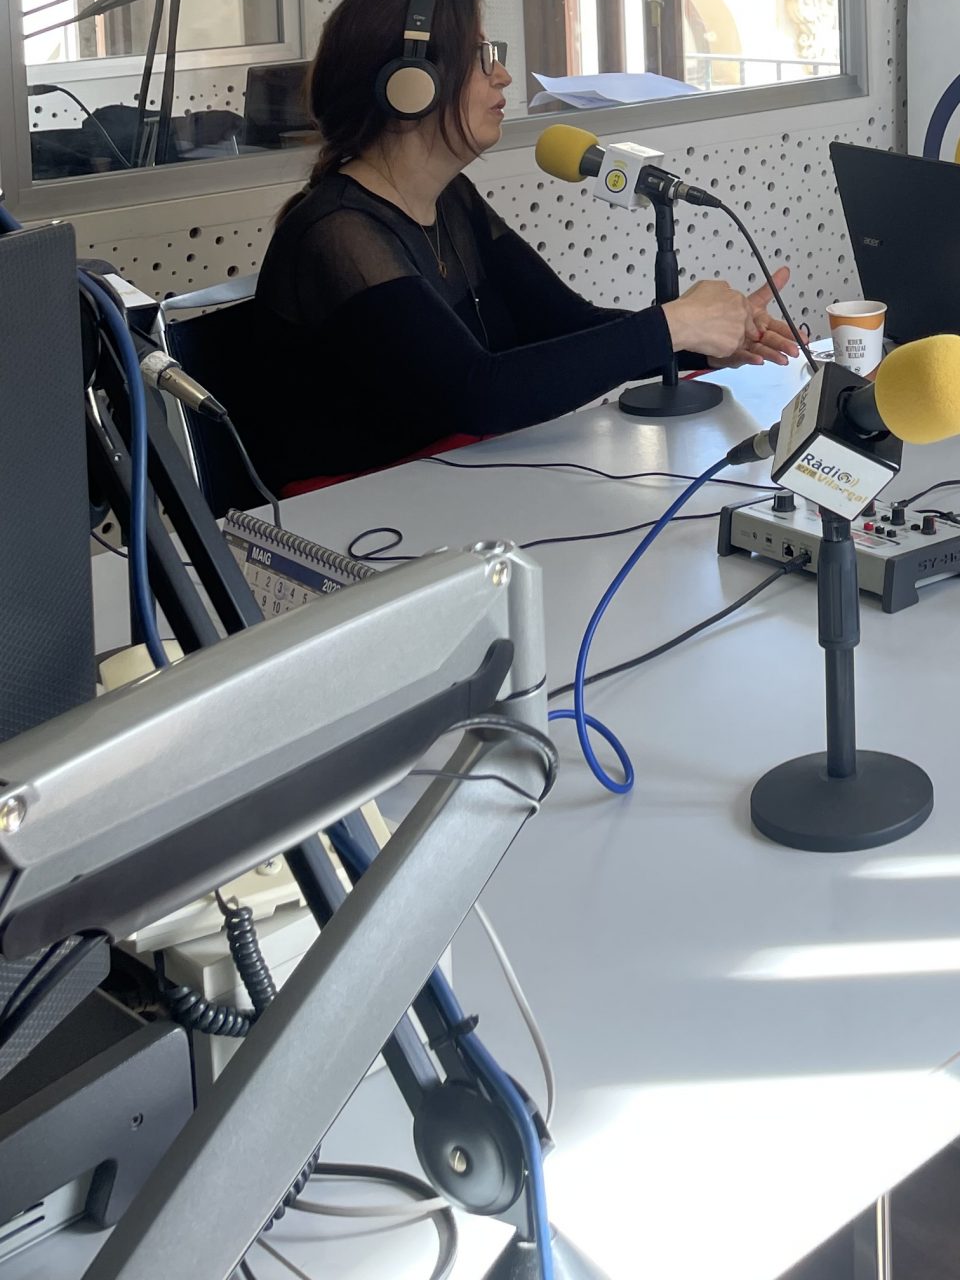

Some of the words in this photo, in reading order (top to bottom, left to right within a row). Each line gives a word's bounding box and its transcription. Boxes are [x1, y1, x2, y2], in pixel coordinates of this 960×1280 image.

[252, 546, 272, 566] MAIG
[265, 576, 272, 587] 2
[278, 582, 284, 593] 3
[289, 588, 296, 599] 4
[302, 593, 308, 604] 5
[261, 595, 267, 607] 9
[272, 601, 281, 614] 10
